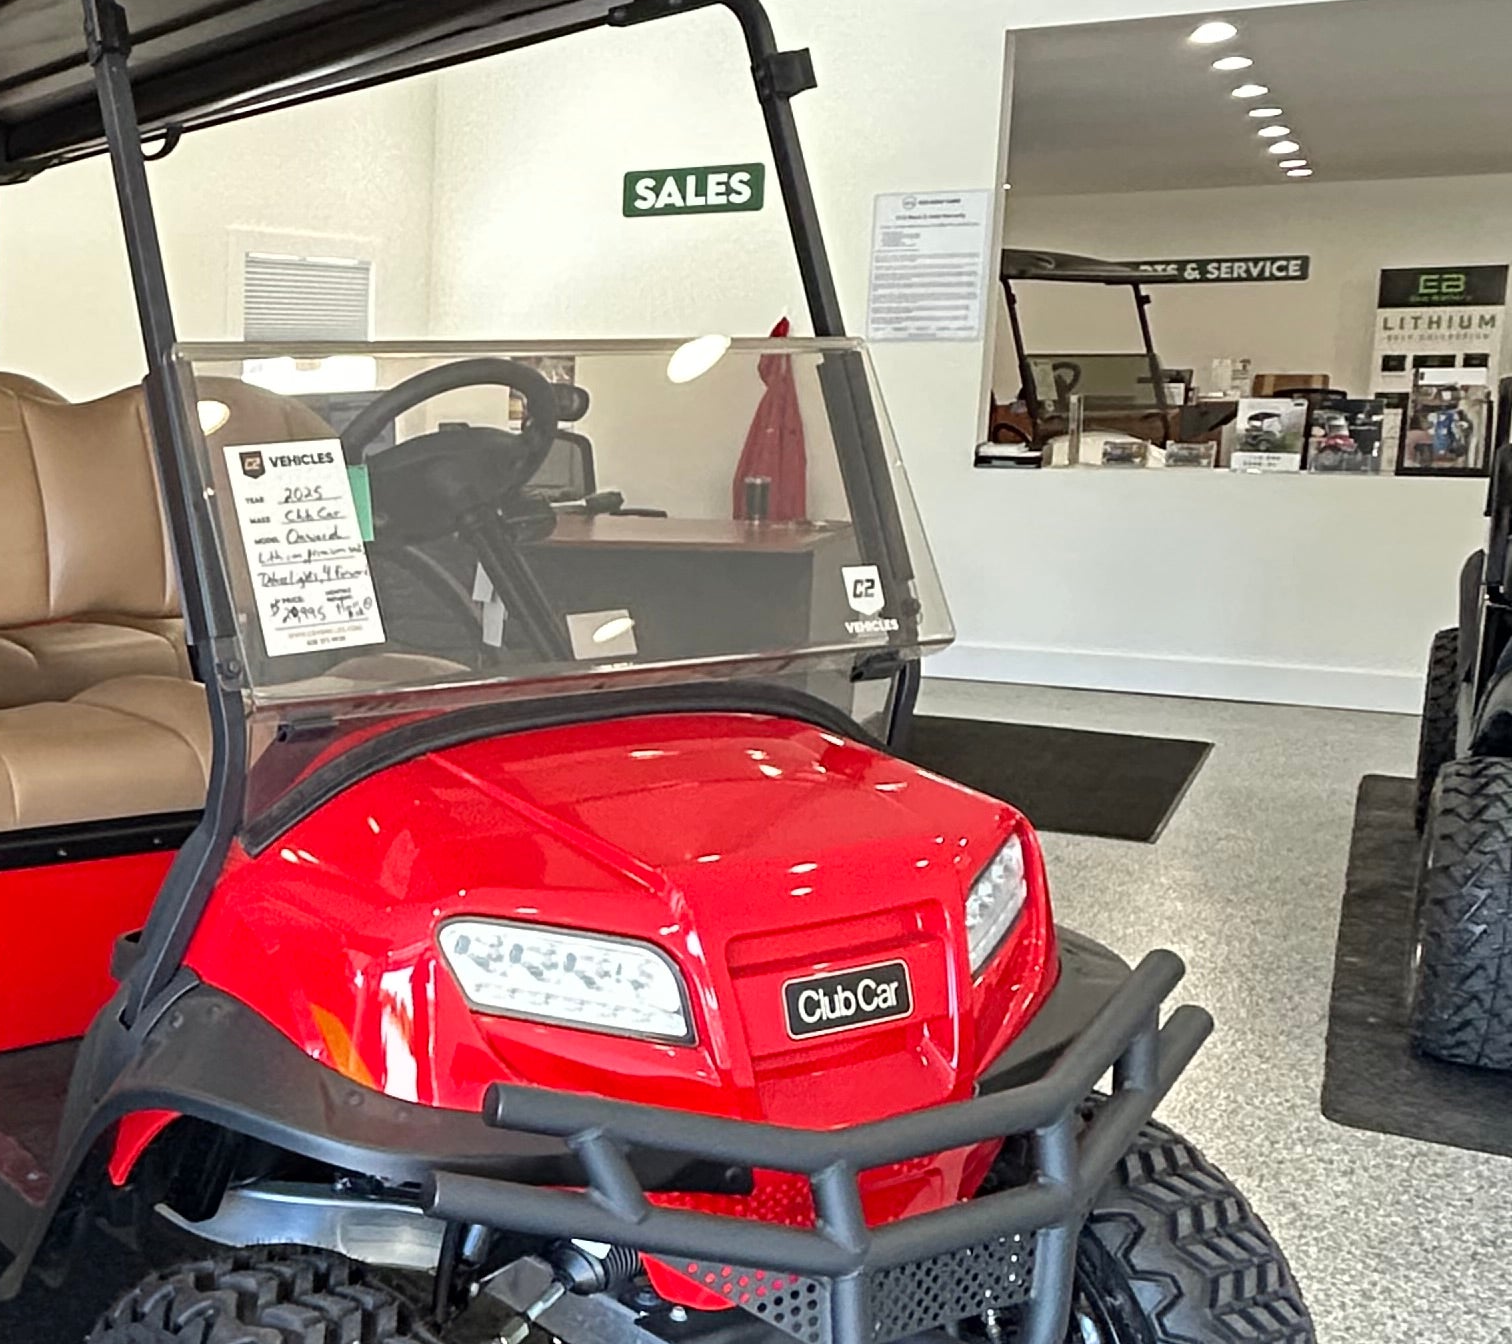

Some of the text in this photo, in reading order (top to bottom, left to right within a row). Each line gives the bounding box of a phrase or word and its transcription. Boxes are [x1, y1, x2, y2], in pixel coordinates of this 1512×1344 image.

[634, 172, 752, 210] SALES
[1183, 263, 1201, 279] &
[1206, 260, 1302, 279] SERVICE
[1382, 314, 1497, 331] LITHIUM
[269, 452, 335, 468] VEHICLES
[283, 485, 323, 504] 2025
[852, 578, 876, 599] C2
[844, 618, 899, 634] VEHICLES
